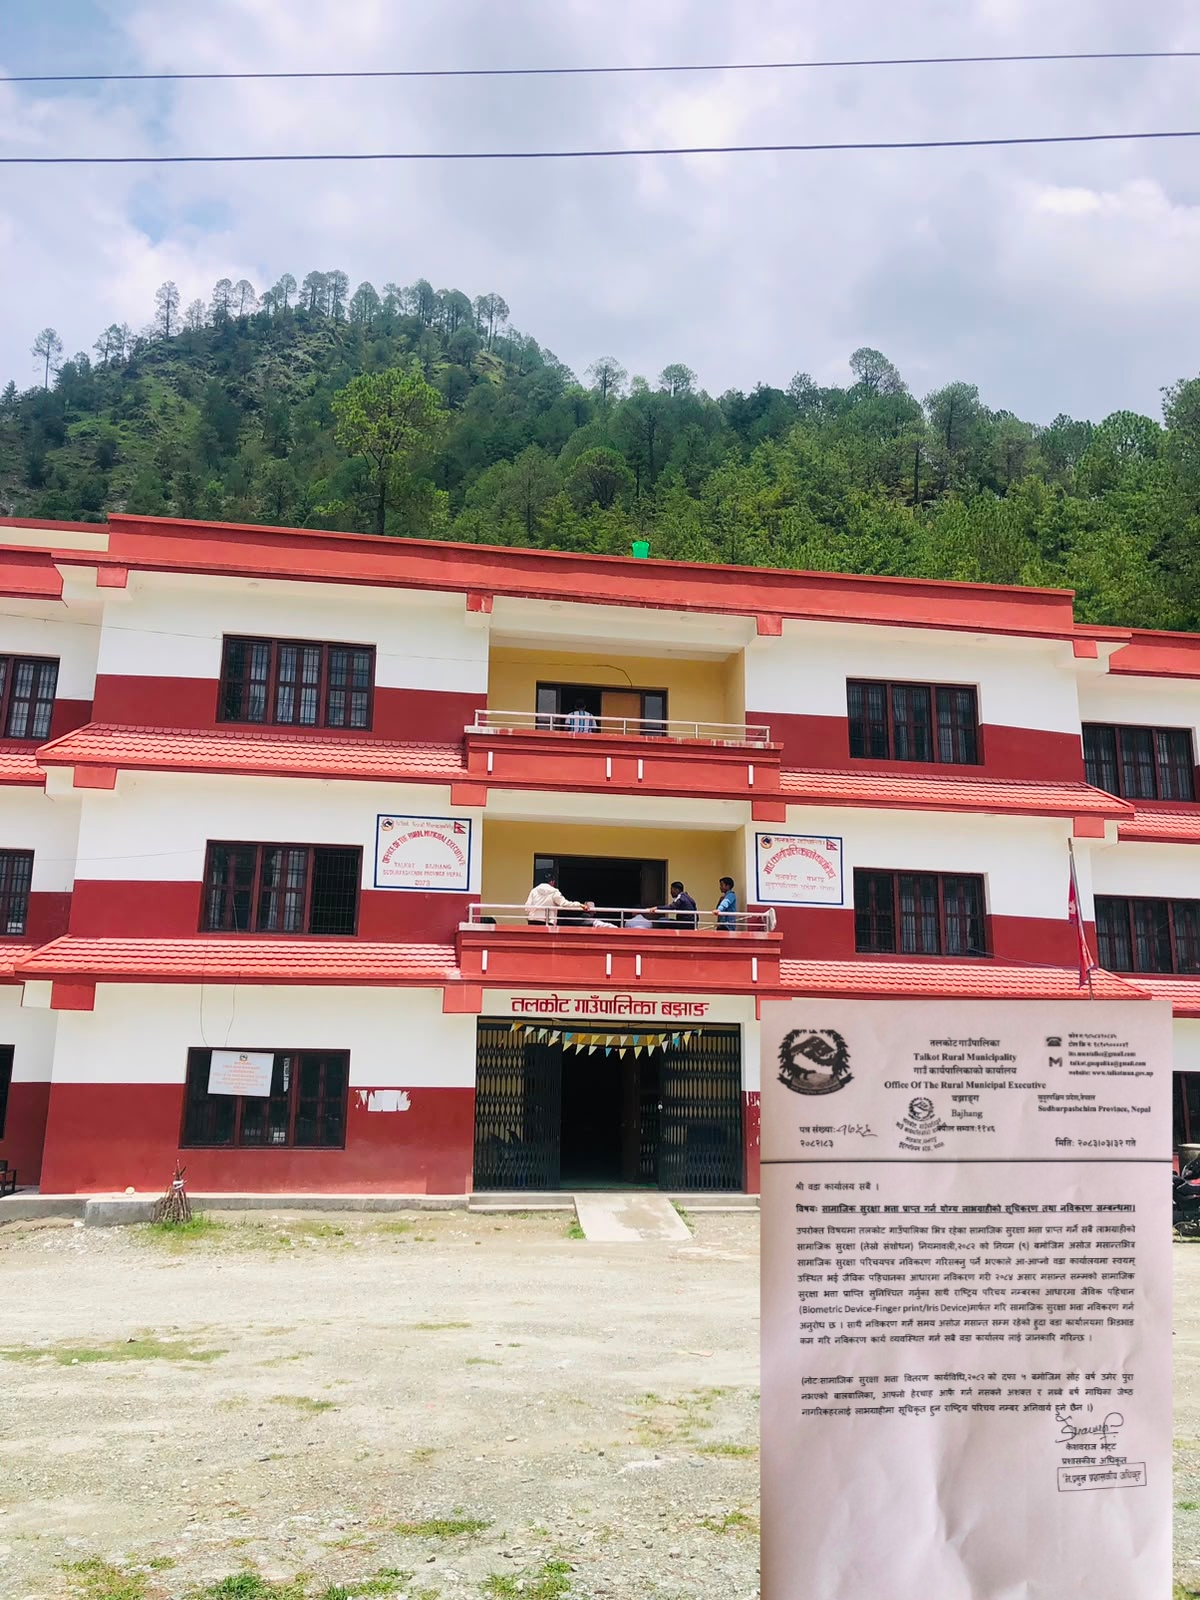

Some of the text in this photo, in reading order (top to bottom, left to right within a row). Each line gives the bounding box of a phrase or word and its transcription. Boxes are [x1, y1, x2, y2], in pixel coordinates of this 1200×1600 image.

[510, 993, 710, 1018] तलकोट गाउँपालिका बझाङ
[929, 1037, 1000, 1047] तलकोट गाउँपालिका
[942, 1053, 965, 1061] Rural
[967, 1053, 1017, 1063] Municipality
[913, 1065, 1017, 1074] गाउँ कार्यपालिकाको कार्यालय
[884, 1081, 1046, 1090] Office Of The Rural Municipal Executive
[951, 1109, 983, 1119] Bajhang
[1131, 1106, 1151, 1114] Nepal
[1125, 1137, 1136, 1146] गते
[824, 1181, 855, 1190] कार्यालय
[859, 1181, 871, 1190] सबै
[1041, 1205, 1057, 1213] तथा
[827, 1225, 856, 1234] विषयमा
[858, 1225, 886, 1234] तलकोट
[948, 1226, 967, 1235] रहेका
[969, 1225, 1003, 1234] सामाजिक
[1005, 1227, 1026, 1237] सुरक्षा
[797, 1241, 831, 1250] सामाजिक
[835, 1243, 856, 1254] सुरक्षा
[979, 1241, 989, 1249] को
[993, 1241, 1015, 1249] नियम
[1069, 1240, 1092, 1249] असोज
[797, 1257, 831, 1266] सामाजिक
[836, 1259, 856, 1269] सुरक्षा
[1069, 1255, 1109, 1264] कार्यालयमा
[1101, 1271, 1135, 1280] सामाजिक
[798, 1291, 819, 1301] सुरक्षा
[799, 1305, 843, 1315] (Biometric
[845, 1305, 901, 1314] Device-Finger
[903, 1304, 939, 1313] print/Iris
[1010, 1302, 1043, 1311] सामाजिक
[1046, 1304, 1067, 1314] सुरक्षा
[939, 1318, 961, 1327] असोज
[1013, 1318, 1031, 1327] रहेको
[1065, 1317, 1104, 1326] कार्यालयमा
[975, 1332, 1005, 1341] कार्यालय
[1008, 1332, 1022, 1342] लाई
[858, 1376, 879, 1387] सुरक्षा
[987, 1372, 997, 1380] को
[1101, 1372, 1117, 1381] उमेर
[971, 1403, 996, 1411] परिचय
